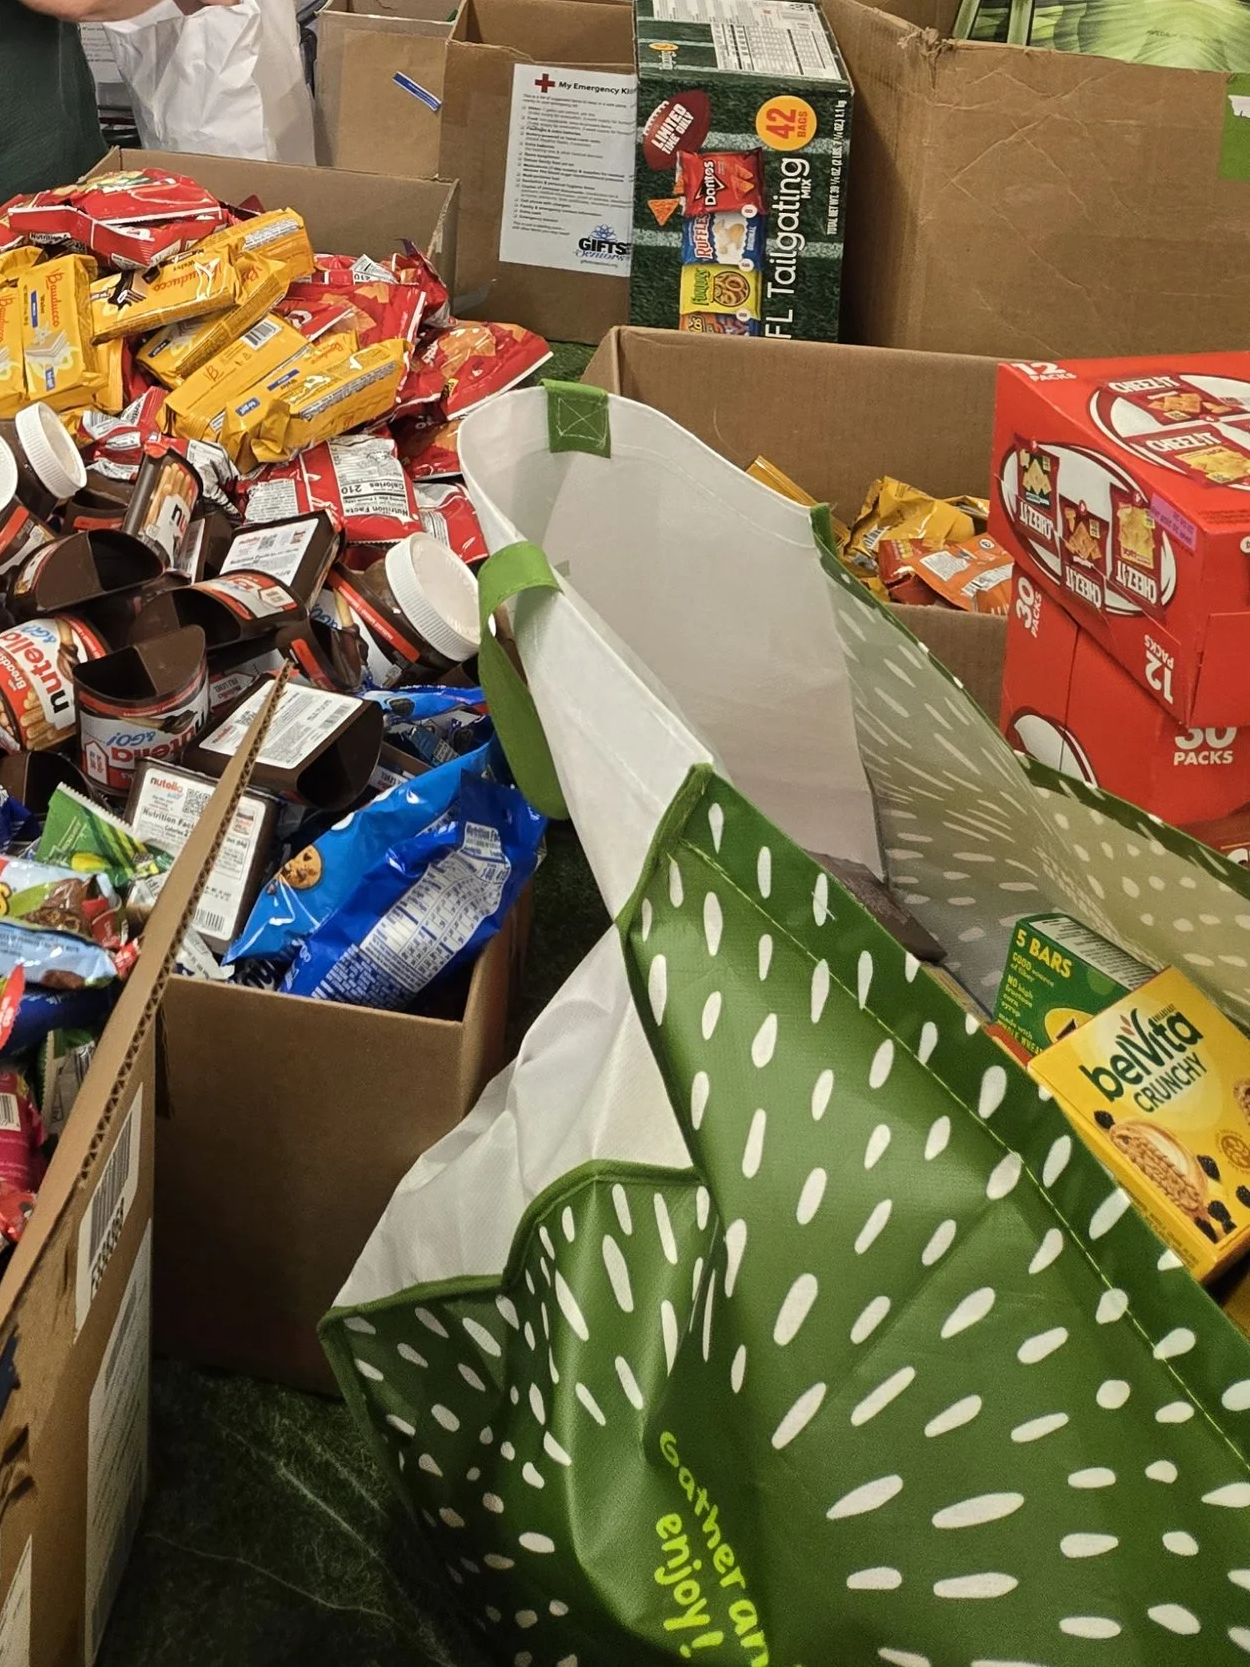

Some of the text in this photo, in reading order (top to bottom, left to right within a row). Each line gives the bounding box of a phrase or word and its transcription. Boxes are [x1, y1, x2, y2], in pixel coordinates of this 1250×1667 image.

[558, 81, 620, 95] My Emergency
[651, 103, 687, 149] LIMITED
[661, 111, 694, 155] TIME ONLY
[765, 108, 797, 140] 42
[797, 111, 808, 138] BAGS
[828, 205, 839, 216] NET
[837, 99, 848, 108] kg
[704, 161, 717, 206] Doritos
[800, 178, 811, 199] MIX
[579, 237, 628, 255] GIFTS
[693, 214, 713, 260] RUFFLES
[764, 157, 811, 339] FL Tailgating
[47, 269, 63, 327] Bauducco
[1012, 362, 1067, 376] 12
[1030, 372, 1077, 382] PACKS
[341, 482, 404, 494] Calories 210
[373, 505, 408, 516] Nutrition
[1016, 577, 1035, 628] 30
[1031, 591, 1042, 638] PACKS
[0, 631, 70, 714] nutella
[1145, 634, 1174, 670] PACKS
[1145, 651, 1173, 704] 12
[105, 731, 157, 747] &GO!
[1173, 750, 1233, 766] PACKS
[149, 776, 184, 794] nutella
[142, 807, 177, 825] Nutrition
[1016, 929, 1073, 978] 5 BARS
[1007, 975, 1018, 987] NO
[1078, 1008, 1204, 1102] belVita
[1133, 1052, 1208, 1113] CRUNCHY
[659, 1431, 770, 1667] Gather an
[654, 1513, 724, 1658] enjoy!
